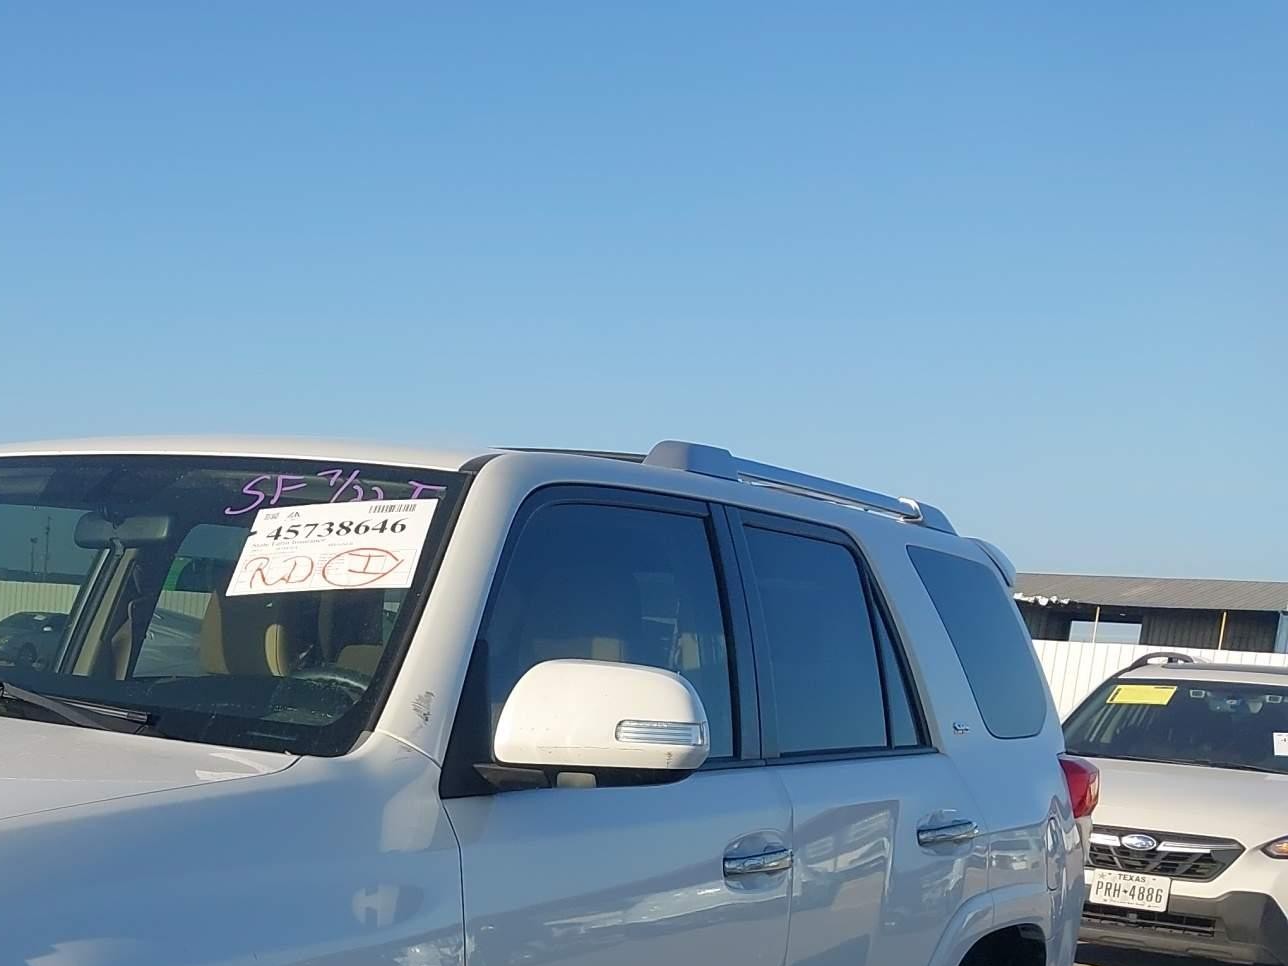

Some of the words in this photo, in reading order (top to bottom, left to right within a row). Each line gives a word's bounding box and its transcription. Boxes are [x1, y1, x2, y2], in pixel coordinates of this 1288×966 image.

[224, 474, 307, 515] SF
[265, 517, 409, 541] 45738646
[1118, 873, 1146, 883] TEXAS
